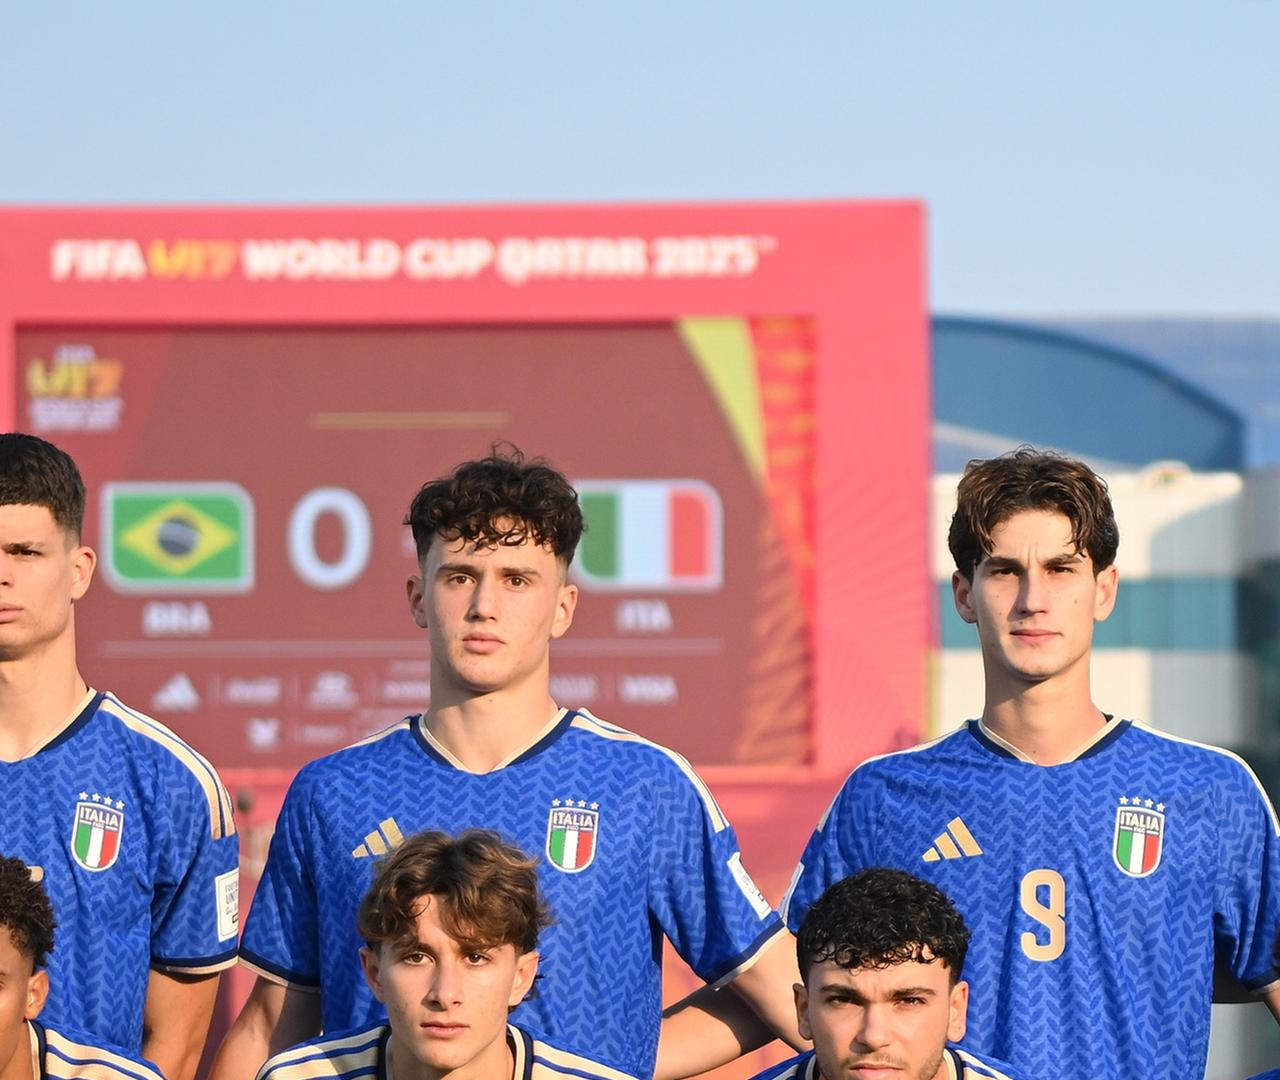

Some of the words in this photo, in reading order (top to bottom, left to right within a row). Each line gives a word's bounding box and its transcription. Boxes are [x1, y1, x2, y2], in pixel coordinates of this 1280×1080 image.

[51, 239, 147, 282] FIFA
[242, 238, 402, 282] WORLD
[405, 237, 494, 281] CUP
[496, 236, 648, 287] QATAR
[652, 235, 759, 278] 2025
[288, 488, 371, 589] 0
[143, 601, 211, 636] BRA
[616, 600, 672, 632] ITA
[80, 806, 119, 827] ITALIA
[553, 811, 593, 828] ITALIA
[1121, 811, 1160, 831] ITALIA
[1019, 869, 1067, 962] 9
